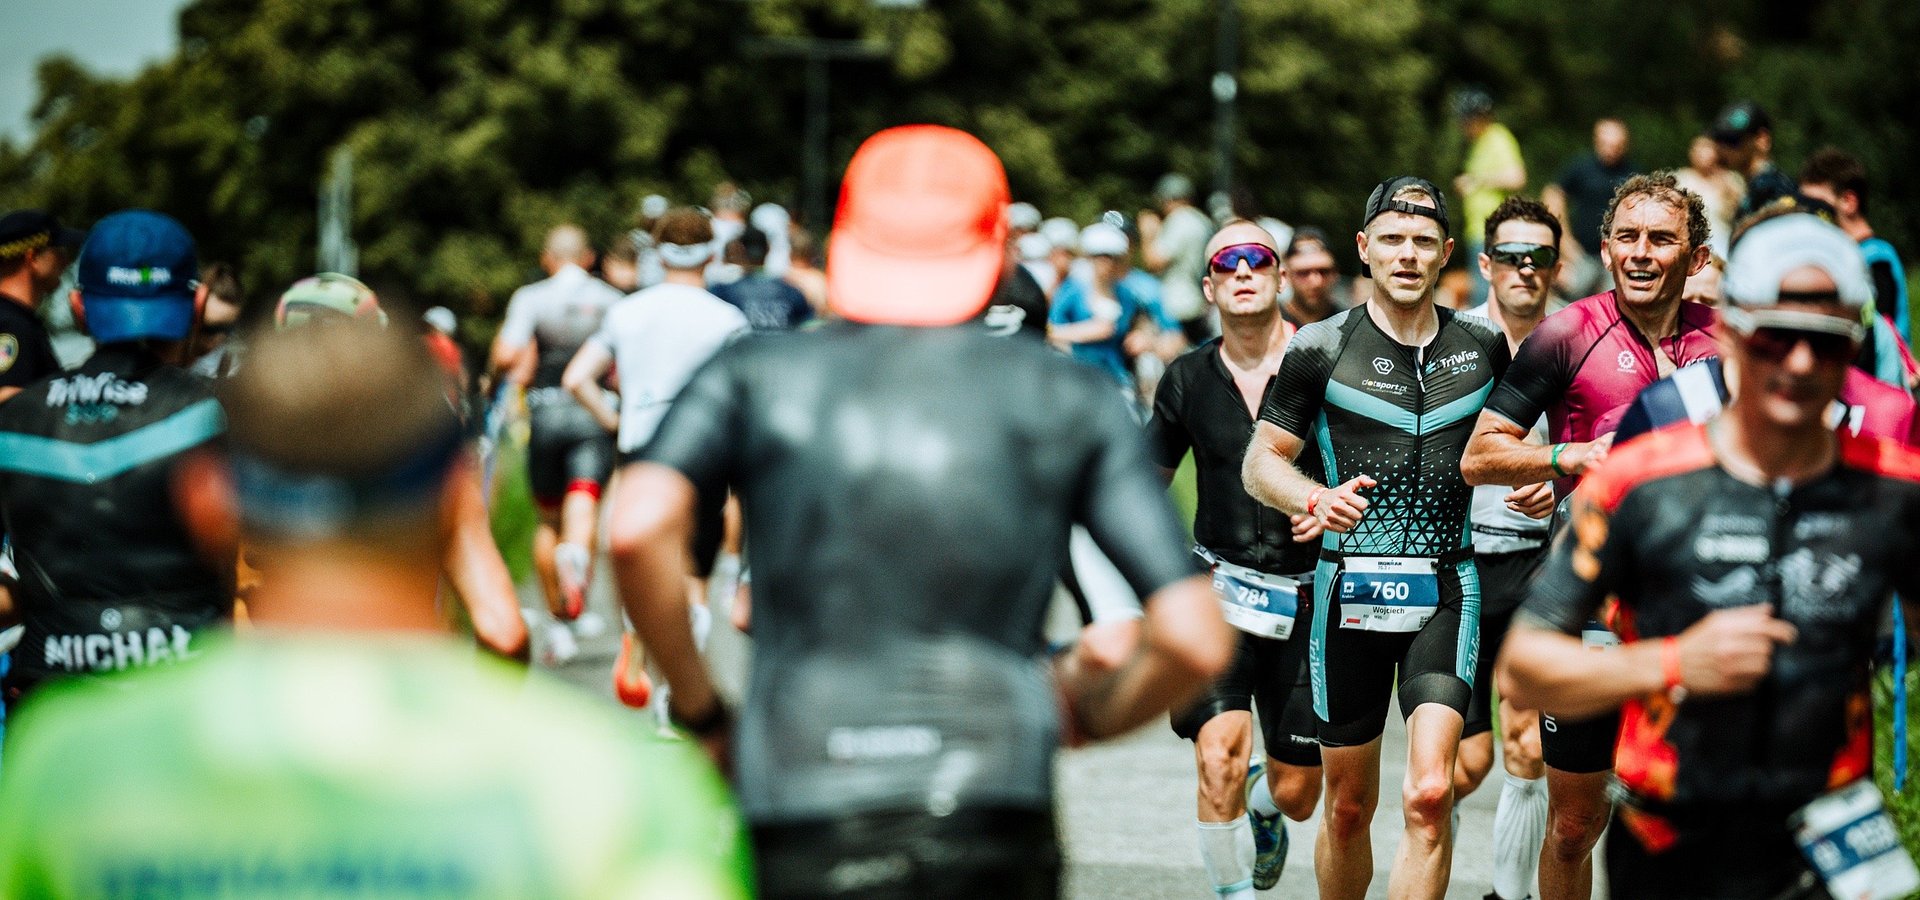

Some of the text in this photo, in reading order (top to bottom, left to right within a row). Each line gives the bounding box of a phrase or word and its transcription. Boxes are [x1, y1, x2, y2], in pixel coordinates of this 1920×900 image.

[1440, 351, 1479, 369] TriWise
[1238, 586, 1269, 608] 784
[1370, 581, 1410, 600] 760
[1372, 606, 1405, 615] Wojciech
